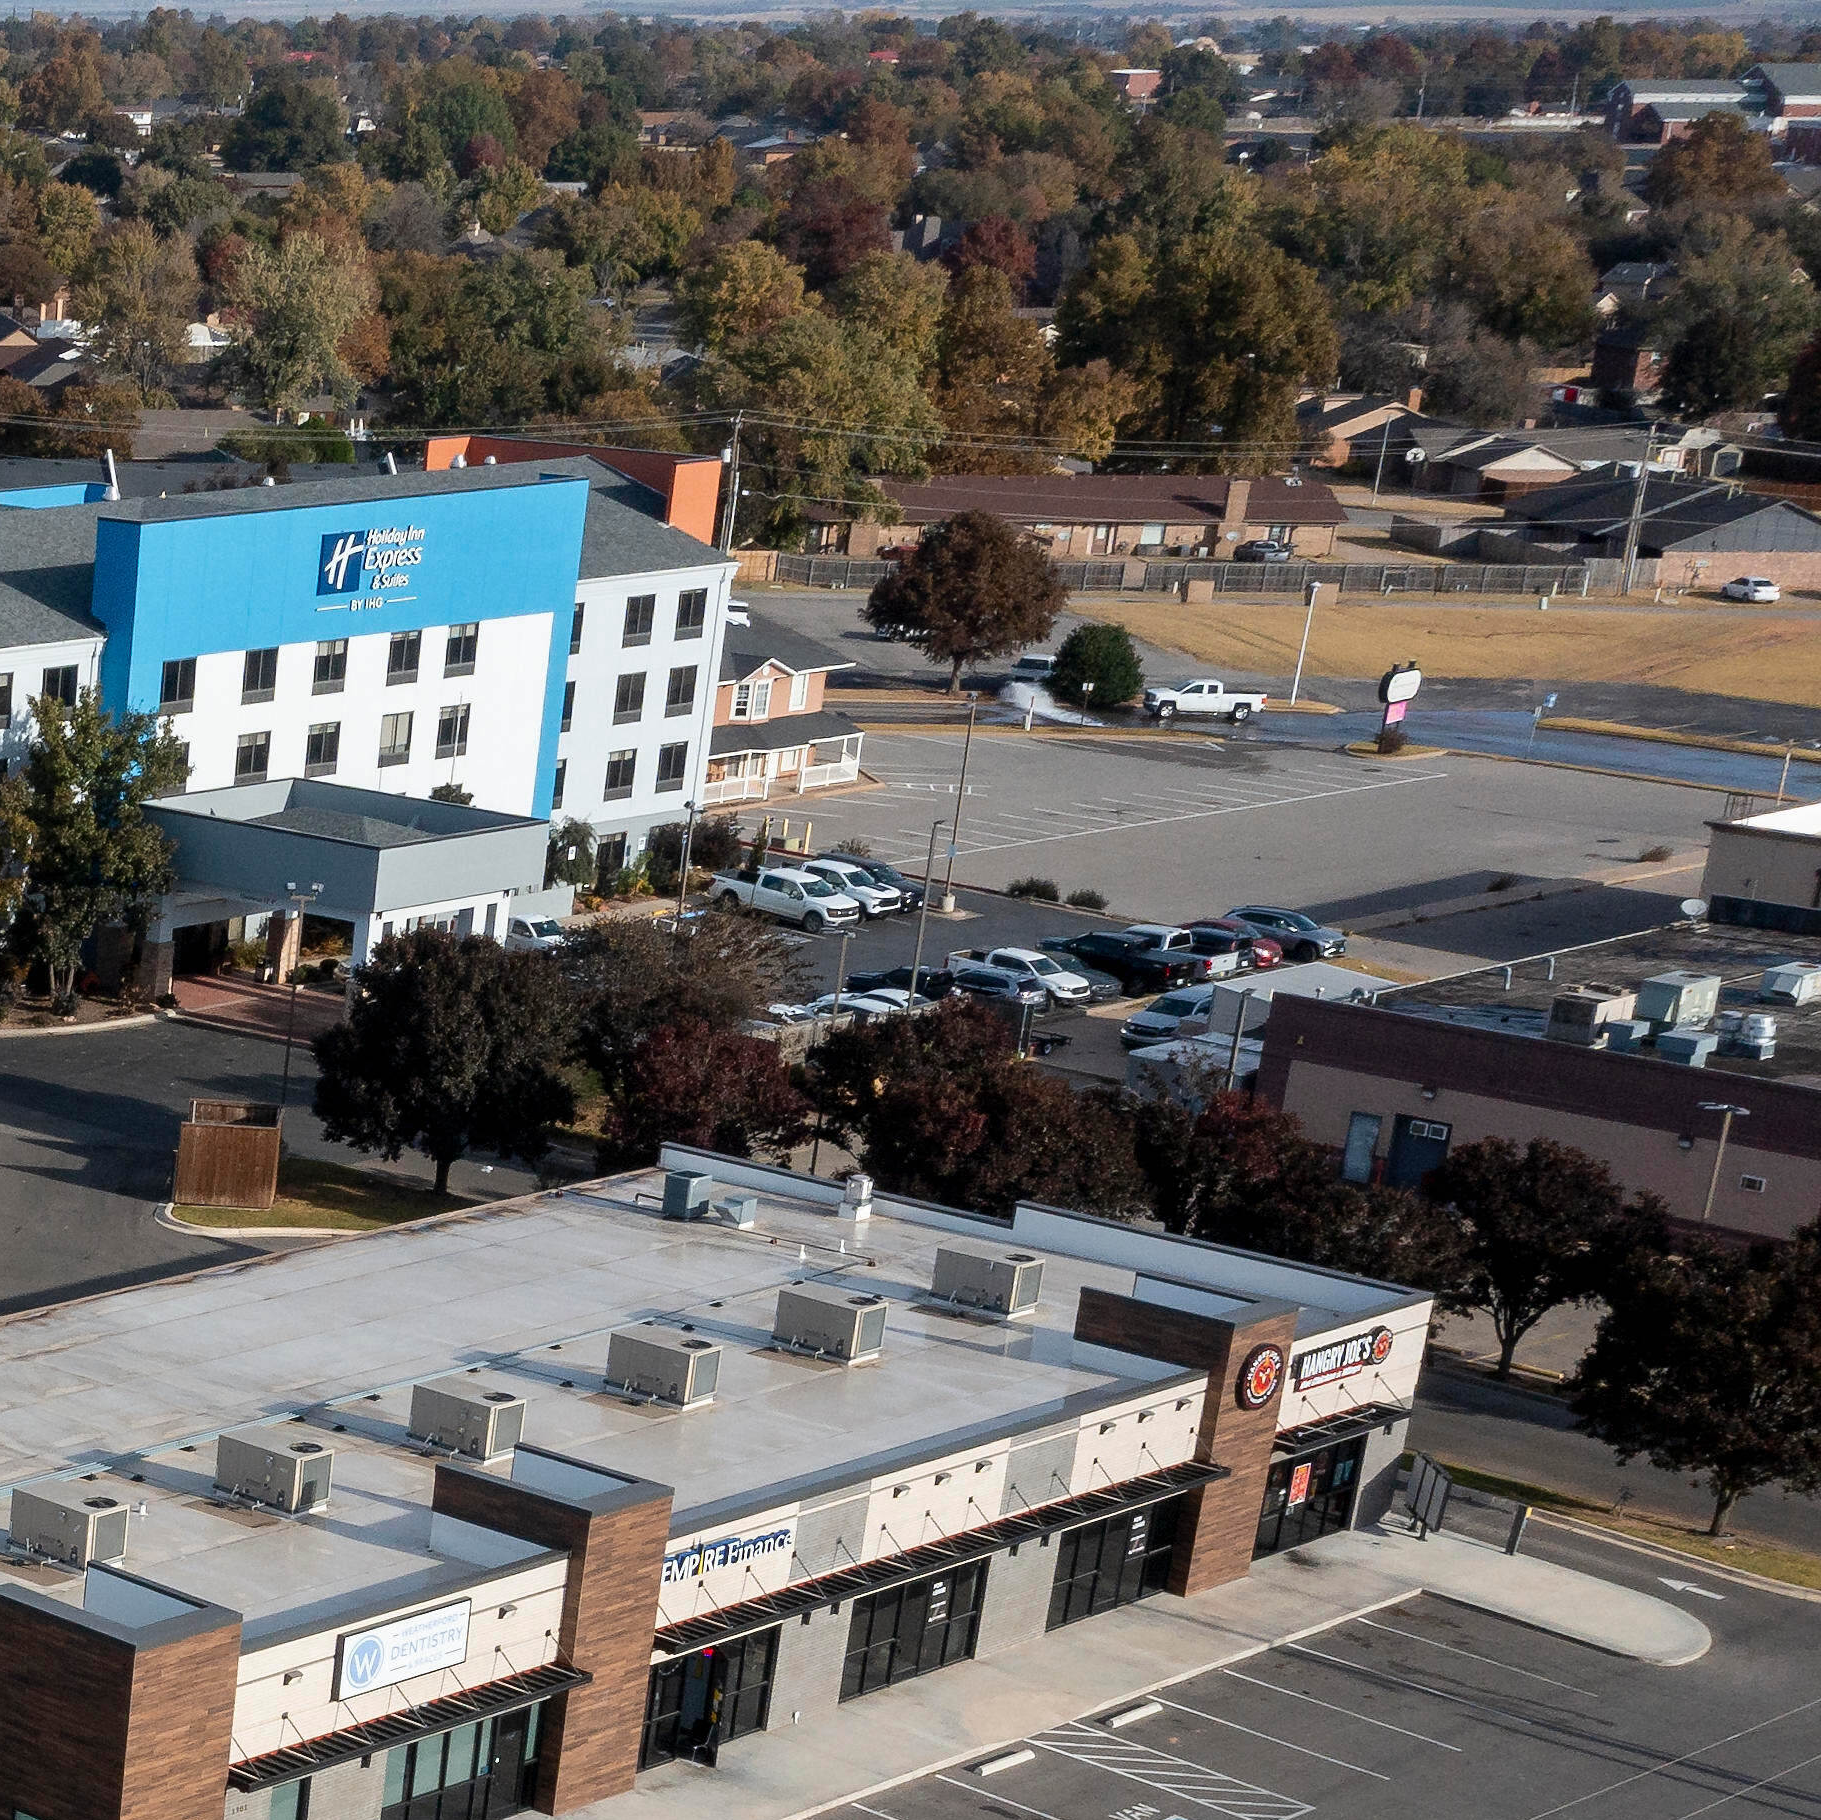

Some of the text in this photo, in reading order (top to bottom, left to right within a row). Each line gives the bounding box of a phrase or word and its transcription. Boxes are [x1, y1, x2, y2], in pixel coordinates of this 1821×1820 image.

[367, 525, 425, 547] Holiday Inn
[364, 547, 423, 574] Express
[372, 573, 409, 590] & Suites
[350, 596, 384, 611] BY IHG
[1301, 1344, 1346, 1379] HANGRY
[661, 1532, 793, 1585] EMPIRE Finance
[390, 1626, 463, 1661] DENTISTRY
